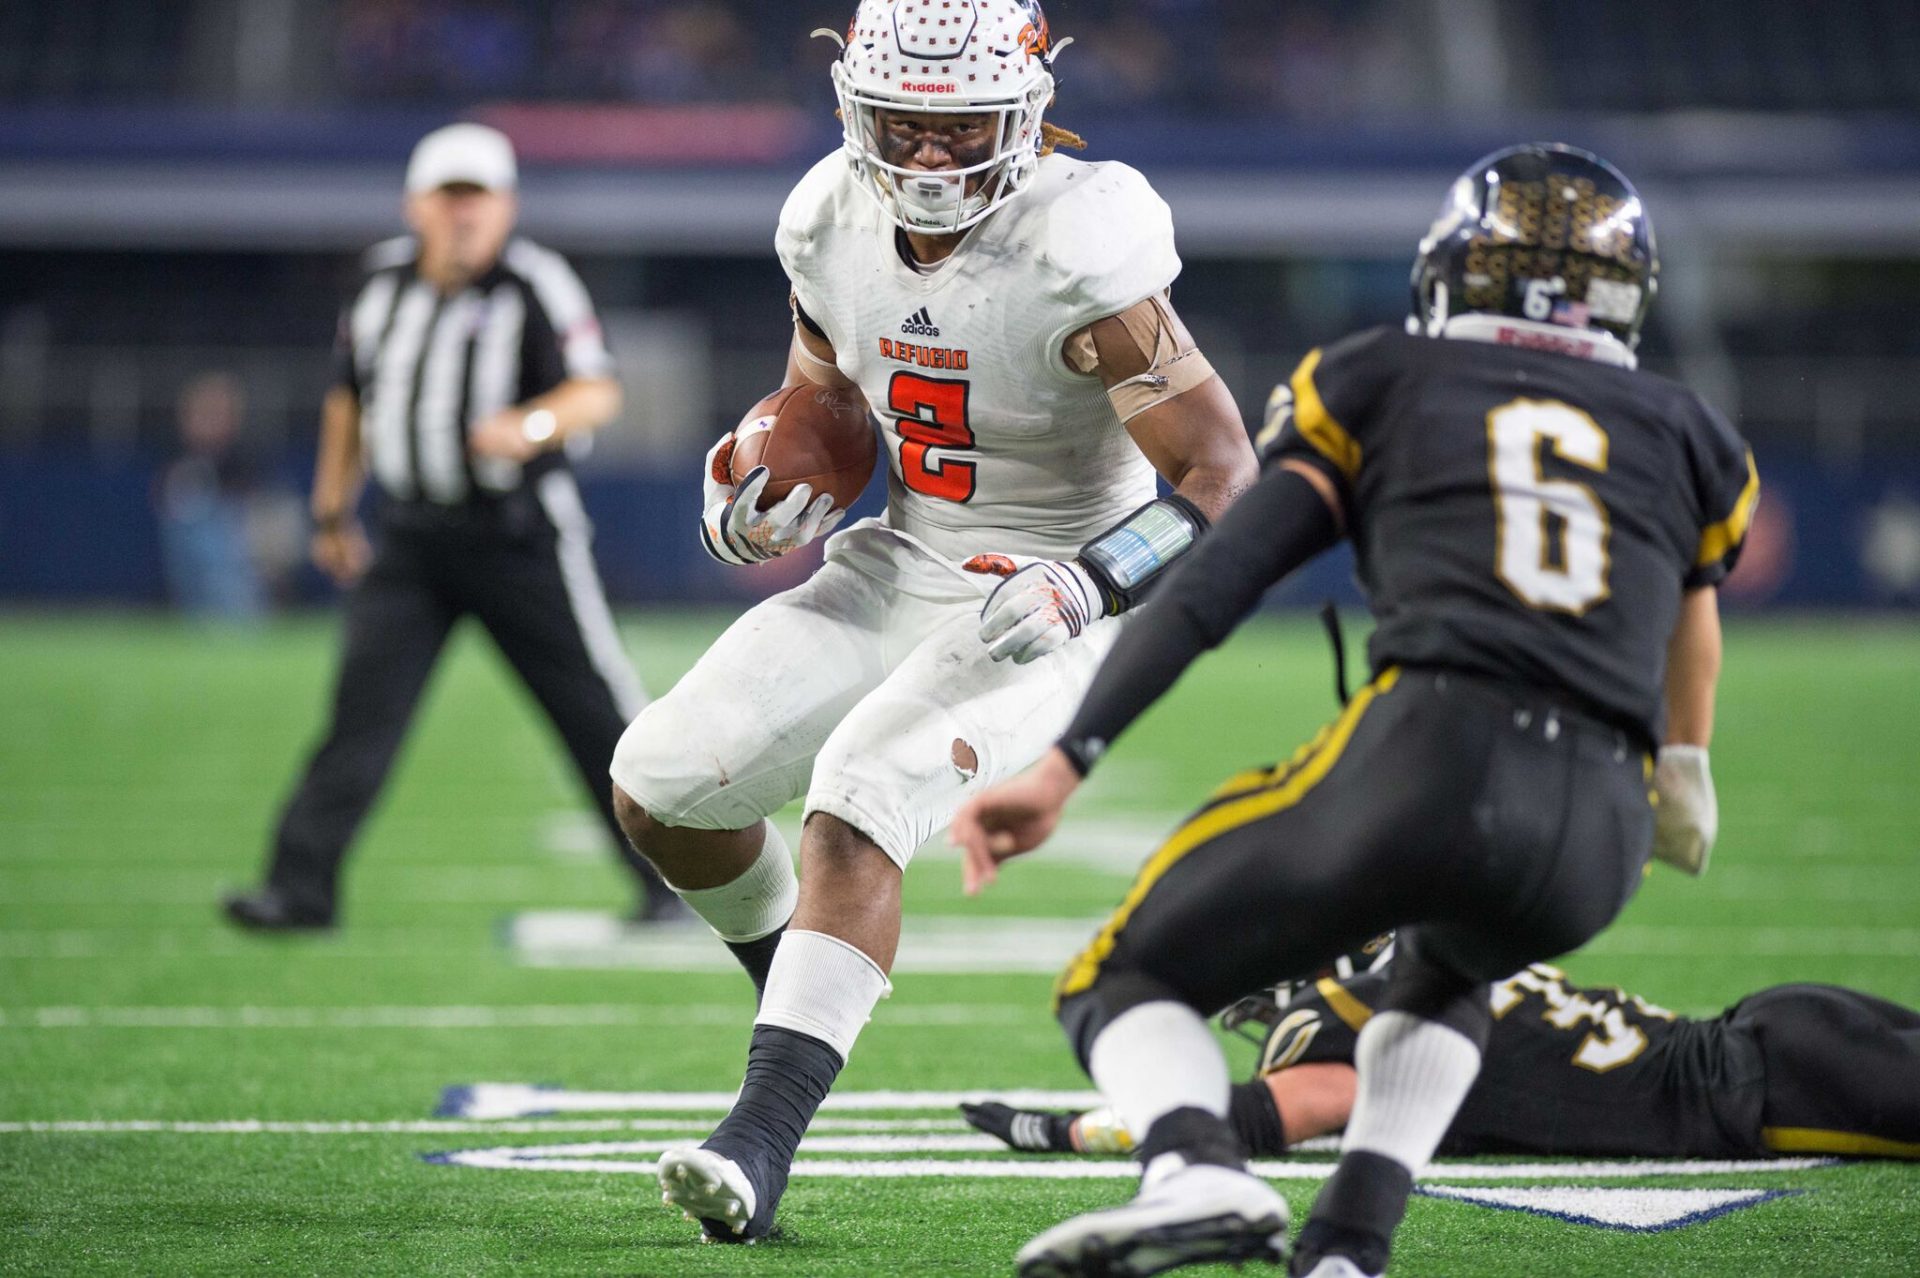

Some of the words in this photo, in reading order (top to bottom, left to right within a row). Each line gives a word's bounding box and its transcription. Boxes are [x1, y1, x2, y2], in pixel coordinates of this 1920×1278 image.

[902, 81, 955, 93] Riddell
[1523, 279, 1551, 320] 6
[901, 323, 940, 337] adidas
[879, 337, 968, 370] REFUGIO
[888, 371, 976, 504] 2
[1485, 396, 1612, 617] 6
